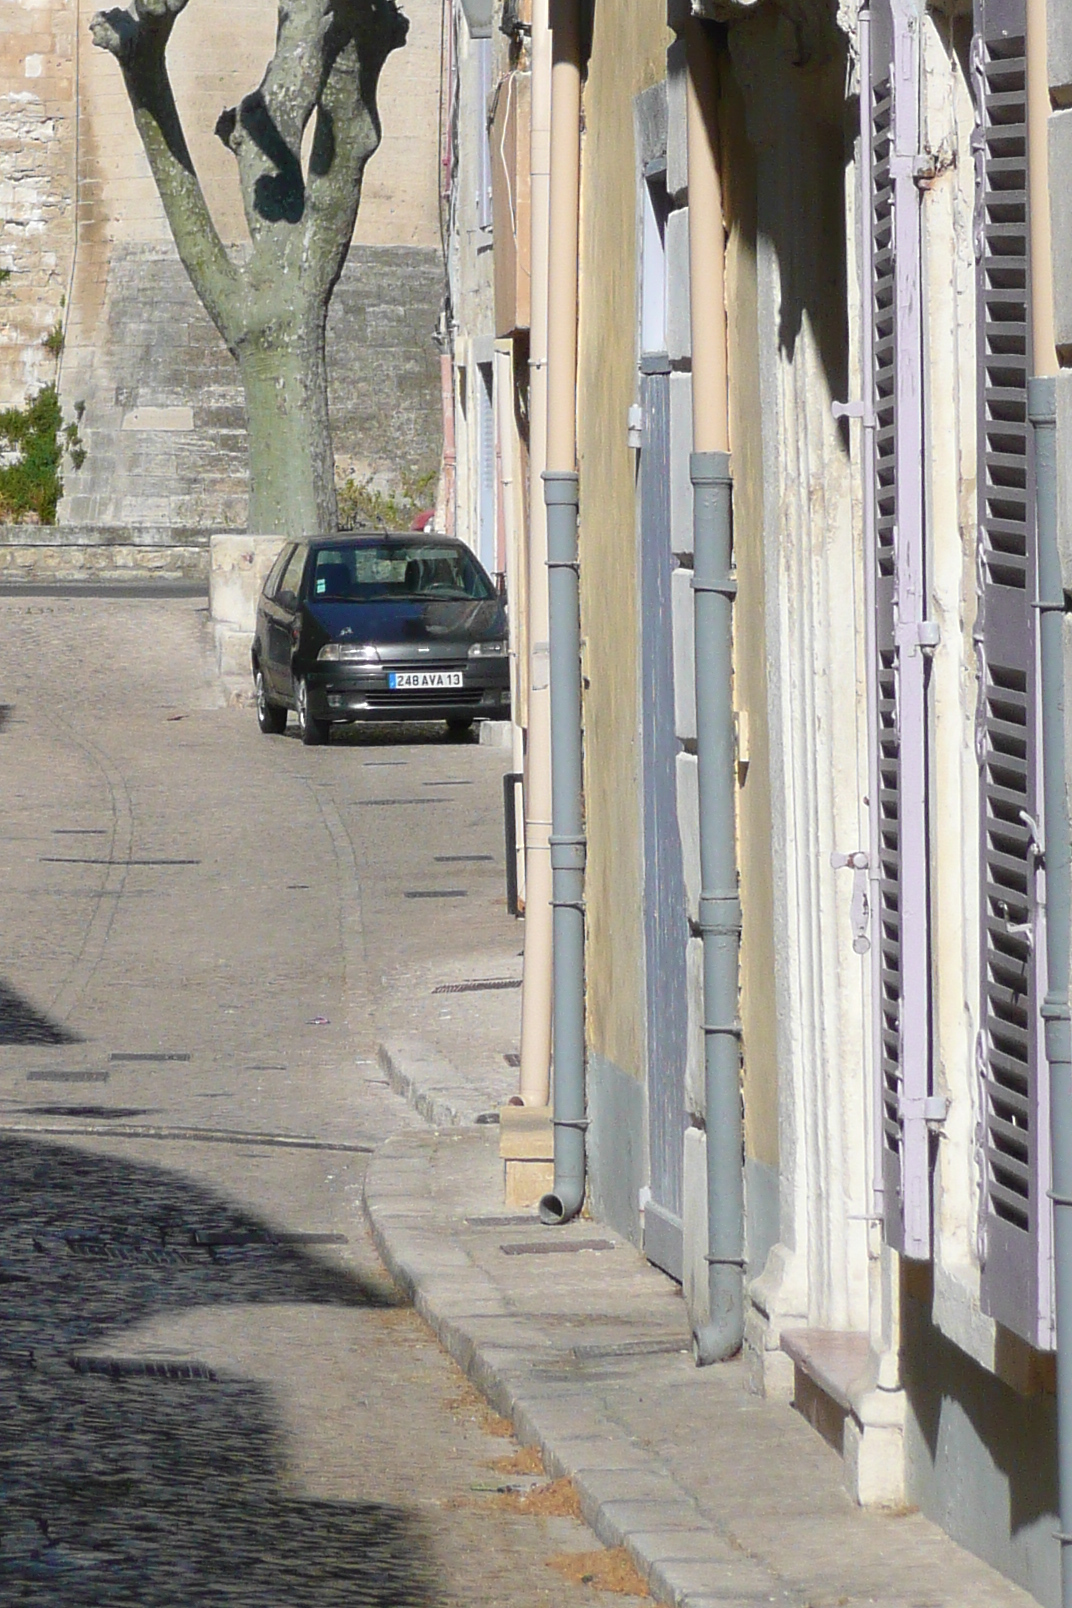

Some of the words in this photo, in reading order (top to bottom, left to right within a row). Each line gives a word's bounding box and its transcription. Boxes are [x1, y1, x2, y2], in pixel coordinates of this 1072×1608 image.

[397, 675, 419, 687] 248
[421, 674, 444, 686] AVA
[447, 673, 460, 686] 13
